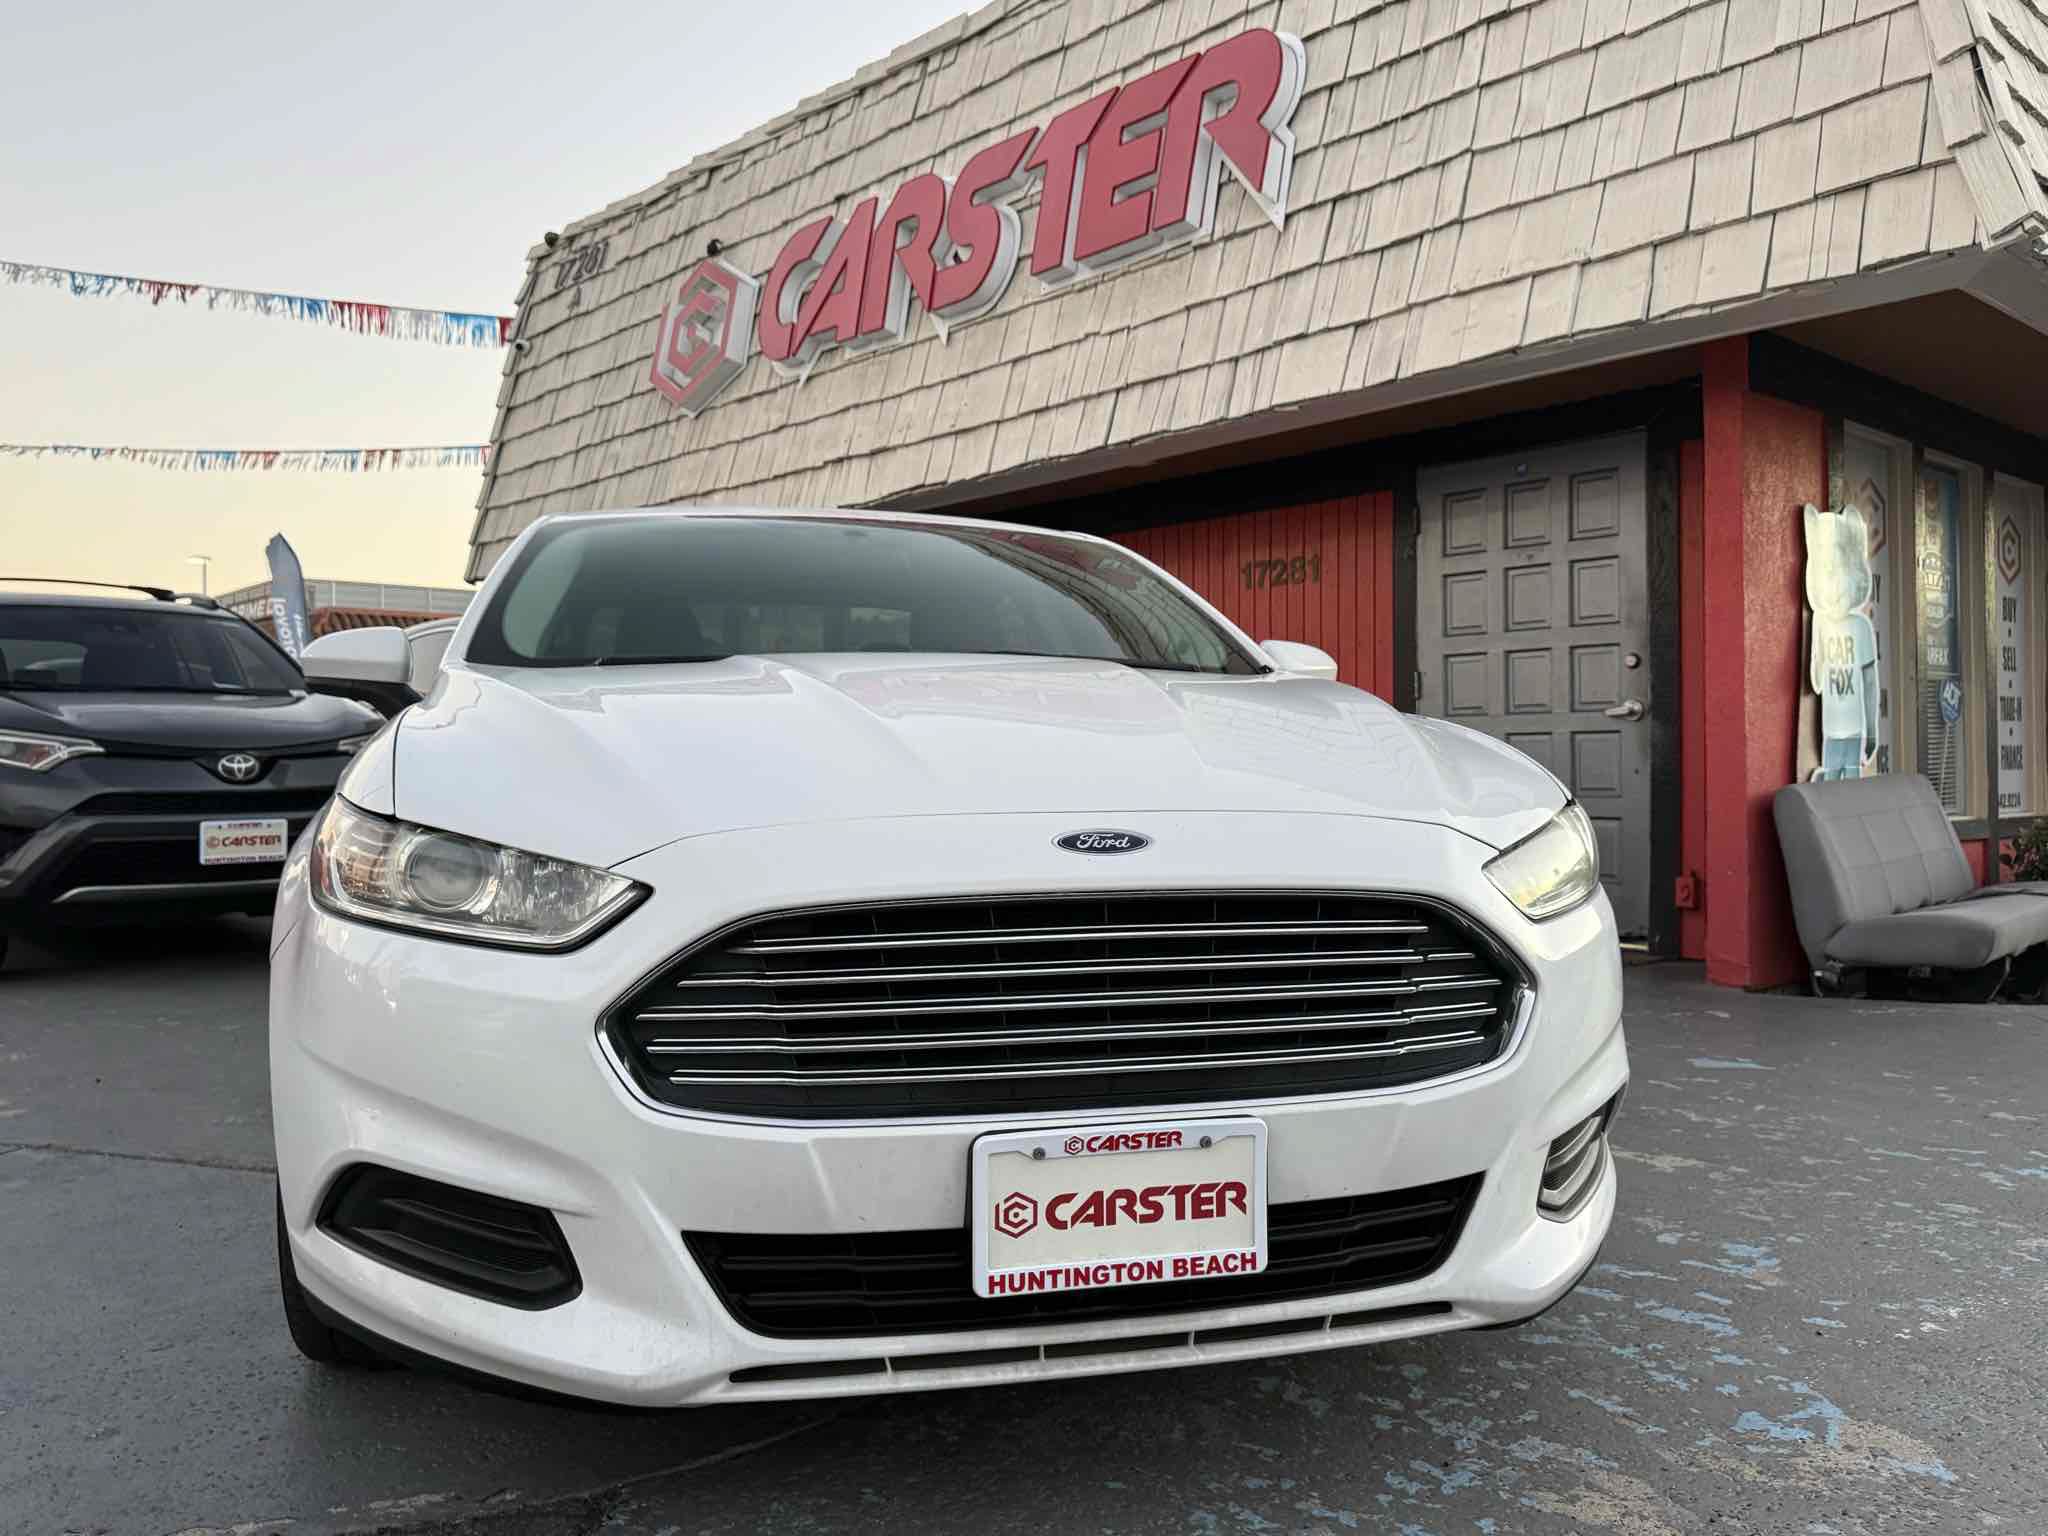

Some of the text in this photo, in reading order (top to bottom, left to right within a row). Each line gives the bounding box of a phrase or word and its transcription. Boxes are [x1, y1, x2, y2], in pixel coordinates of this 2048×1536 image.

[757, 28, 1300, 370] CARSTER
[1242, 553, 1320, 590] 17281
[2002, 595, 2017, 623] BUY
[1827, 635, 1855, 665] CAR
[2002, 646, 2017, 672] SELL
[1828, 667, 1856, 696] FOX
[1076, 832, 1132, 849] Ford
[1086, 1130, 1183, 1152] CARSTER
[1044, 1180, 1248, 1231] CARSTER
[988, 1252, 1258, 1295] HUNTINGTON BEACH
